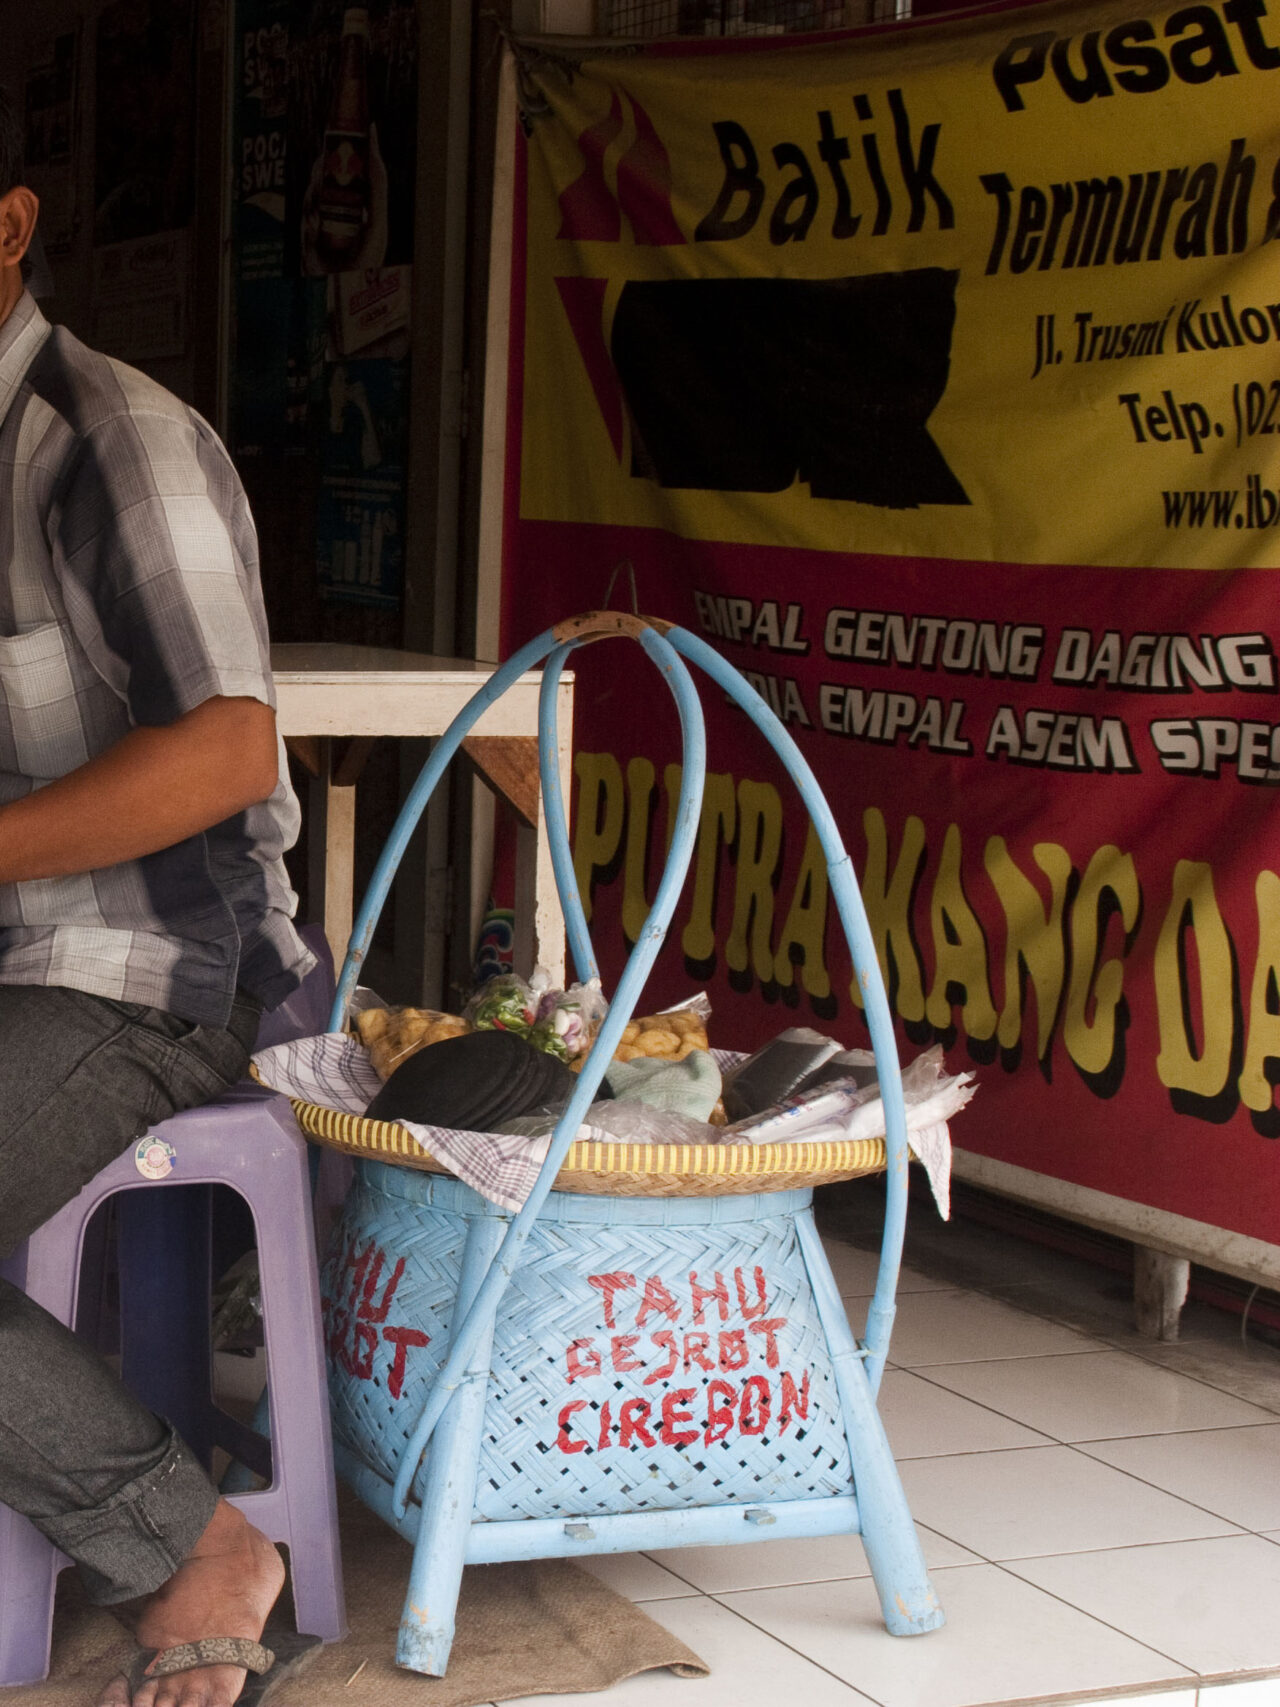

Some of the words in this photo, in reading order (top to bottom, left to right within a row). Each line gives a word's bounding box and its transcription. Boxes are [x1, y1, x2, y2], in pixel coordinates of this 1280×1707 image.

[992, 0, 1280, 113] Pusat
[694, 88, 955, 246] Batik
[980, 138, 1256, 275] Termurah
[1072, 302, 1176, 365] Trusmi
[1118, 390, 1224, 454] Telp.
[1233, 379, 1280, 449] (02
[1162, 474, 1280, 529] www.ib
[694, 589, 808, 652] EMPAL
[824, 608, 1044, 678] GENTONG
[1052, 629, 1275, 688] DAGING
[820, 683, 969, 752] EMPAL
[985, 706, 1134, 769] ASEM
[1150, 719, 1280, 781] SPE
[568, 752, 834, 1000] PUTRA
[588, 1265, 768, 1330] TAHU
[554, 1369, 811, 1454] CIREBON
